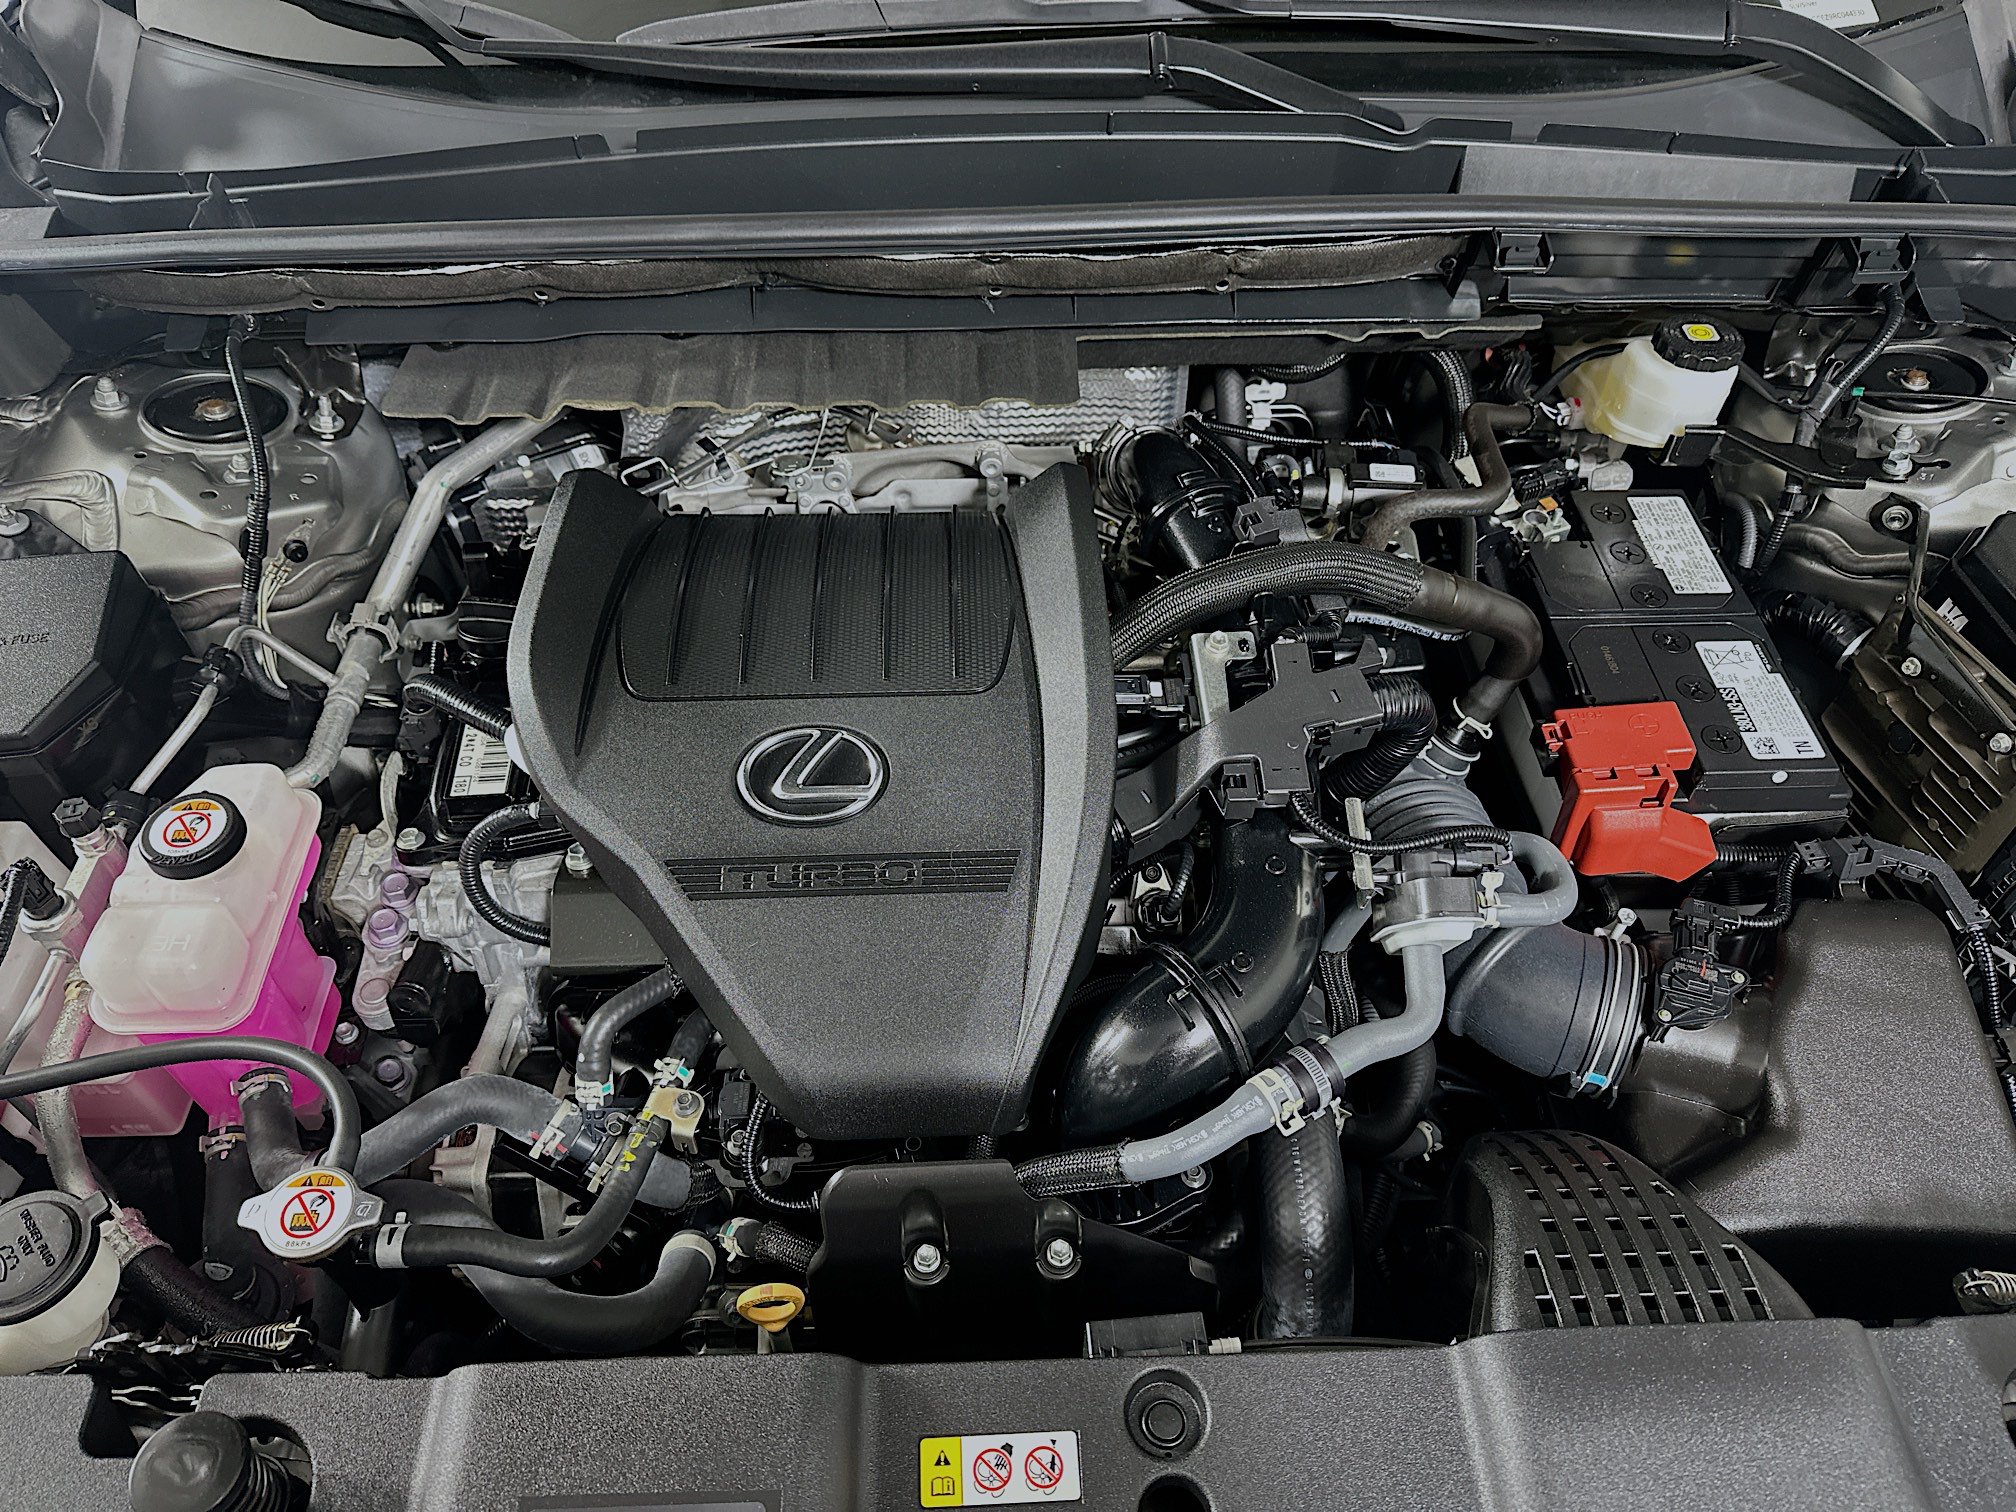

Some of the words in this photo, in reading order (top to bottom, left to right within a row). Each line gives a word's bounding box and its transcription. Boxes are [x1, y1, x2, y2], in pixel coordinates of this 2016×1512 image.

[11, 632, 50, 645] FUSE
[1793, 741, 1814, 754] TN
[720, 860, 916, 892] TURBO
[20, 1209, 43, 1244] WASHER
[37, 1242, 56, 1267] FLUID
[285, 1240, 311, 1248] 88kPa
